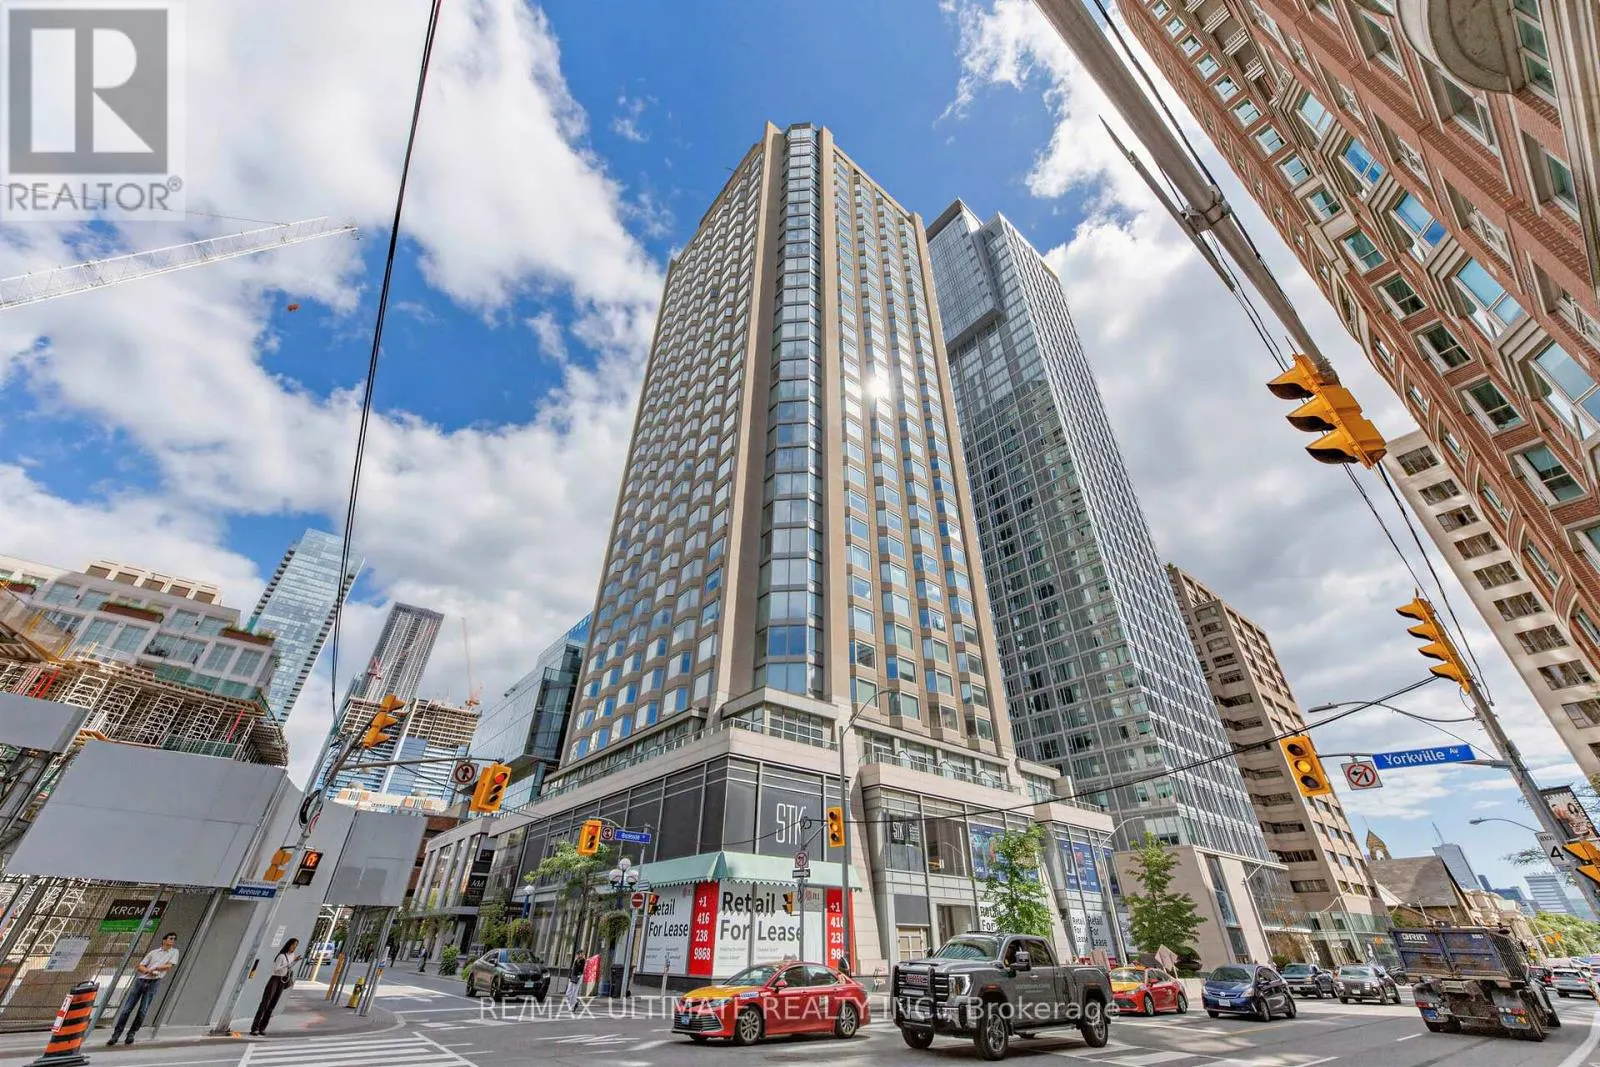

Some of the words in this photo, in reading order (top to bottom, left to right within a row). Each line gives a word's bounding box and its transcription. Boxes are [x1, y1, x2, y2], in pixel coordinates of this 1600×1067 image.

[1384, 750, 1445, 765] Yorkville
[776, 803, 806, 845] STK
[1551, 846, 1564, 861] 4
[654, 898, 675, 916] etail
[699, 895, 707, 908] +1
[722, 892, 776, 913] Retail
[830, 902, 841, 913] +1
[110, 906, 160, 916] KRCMR
[697, 912, 710, 925] 416
[648, 922, 663, 937] For
[664, 922, 689, 937] Lease
[695, 930, 708, 942] 238
[720, 920, 751, 940] For
[758, 921, 801, 941] Lease
[693, 947, 711, 960] 9868
[830, 948, 844, 960] 98
